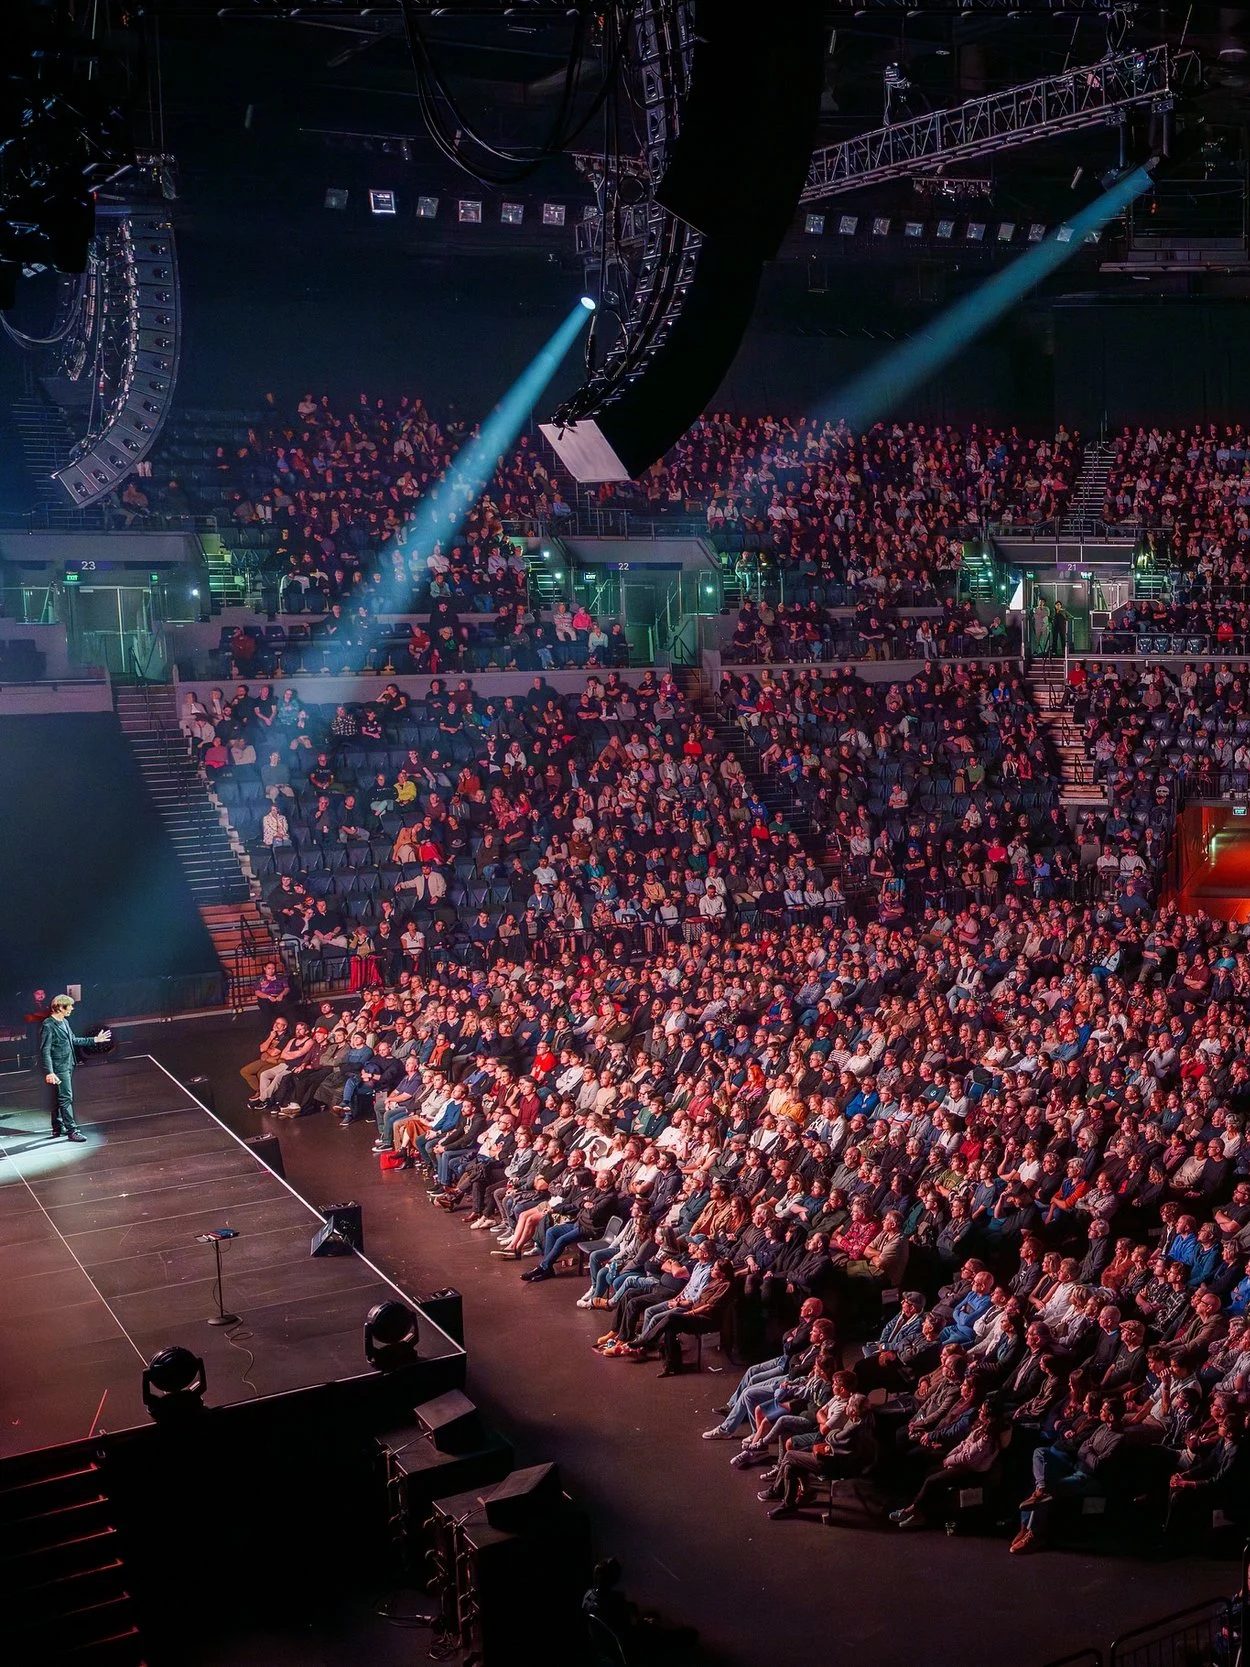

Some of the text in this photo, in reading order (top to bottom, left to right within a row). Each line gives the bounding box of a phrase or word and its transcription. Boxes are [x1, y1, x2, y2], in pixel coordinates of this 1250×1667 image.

[81, 561, 96, 570] 23
[618, 562, 630, 571] 22
[1067, 563, 1077, 571] 21
